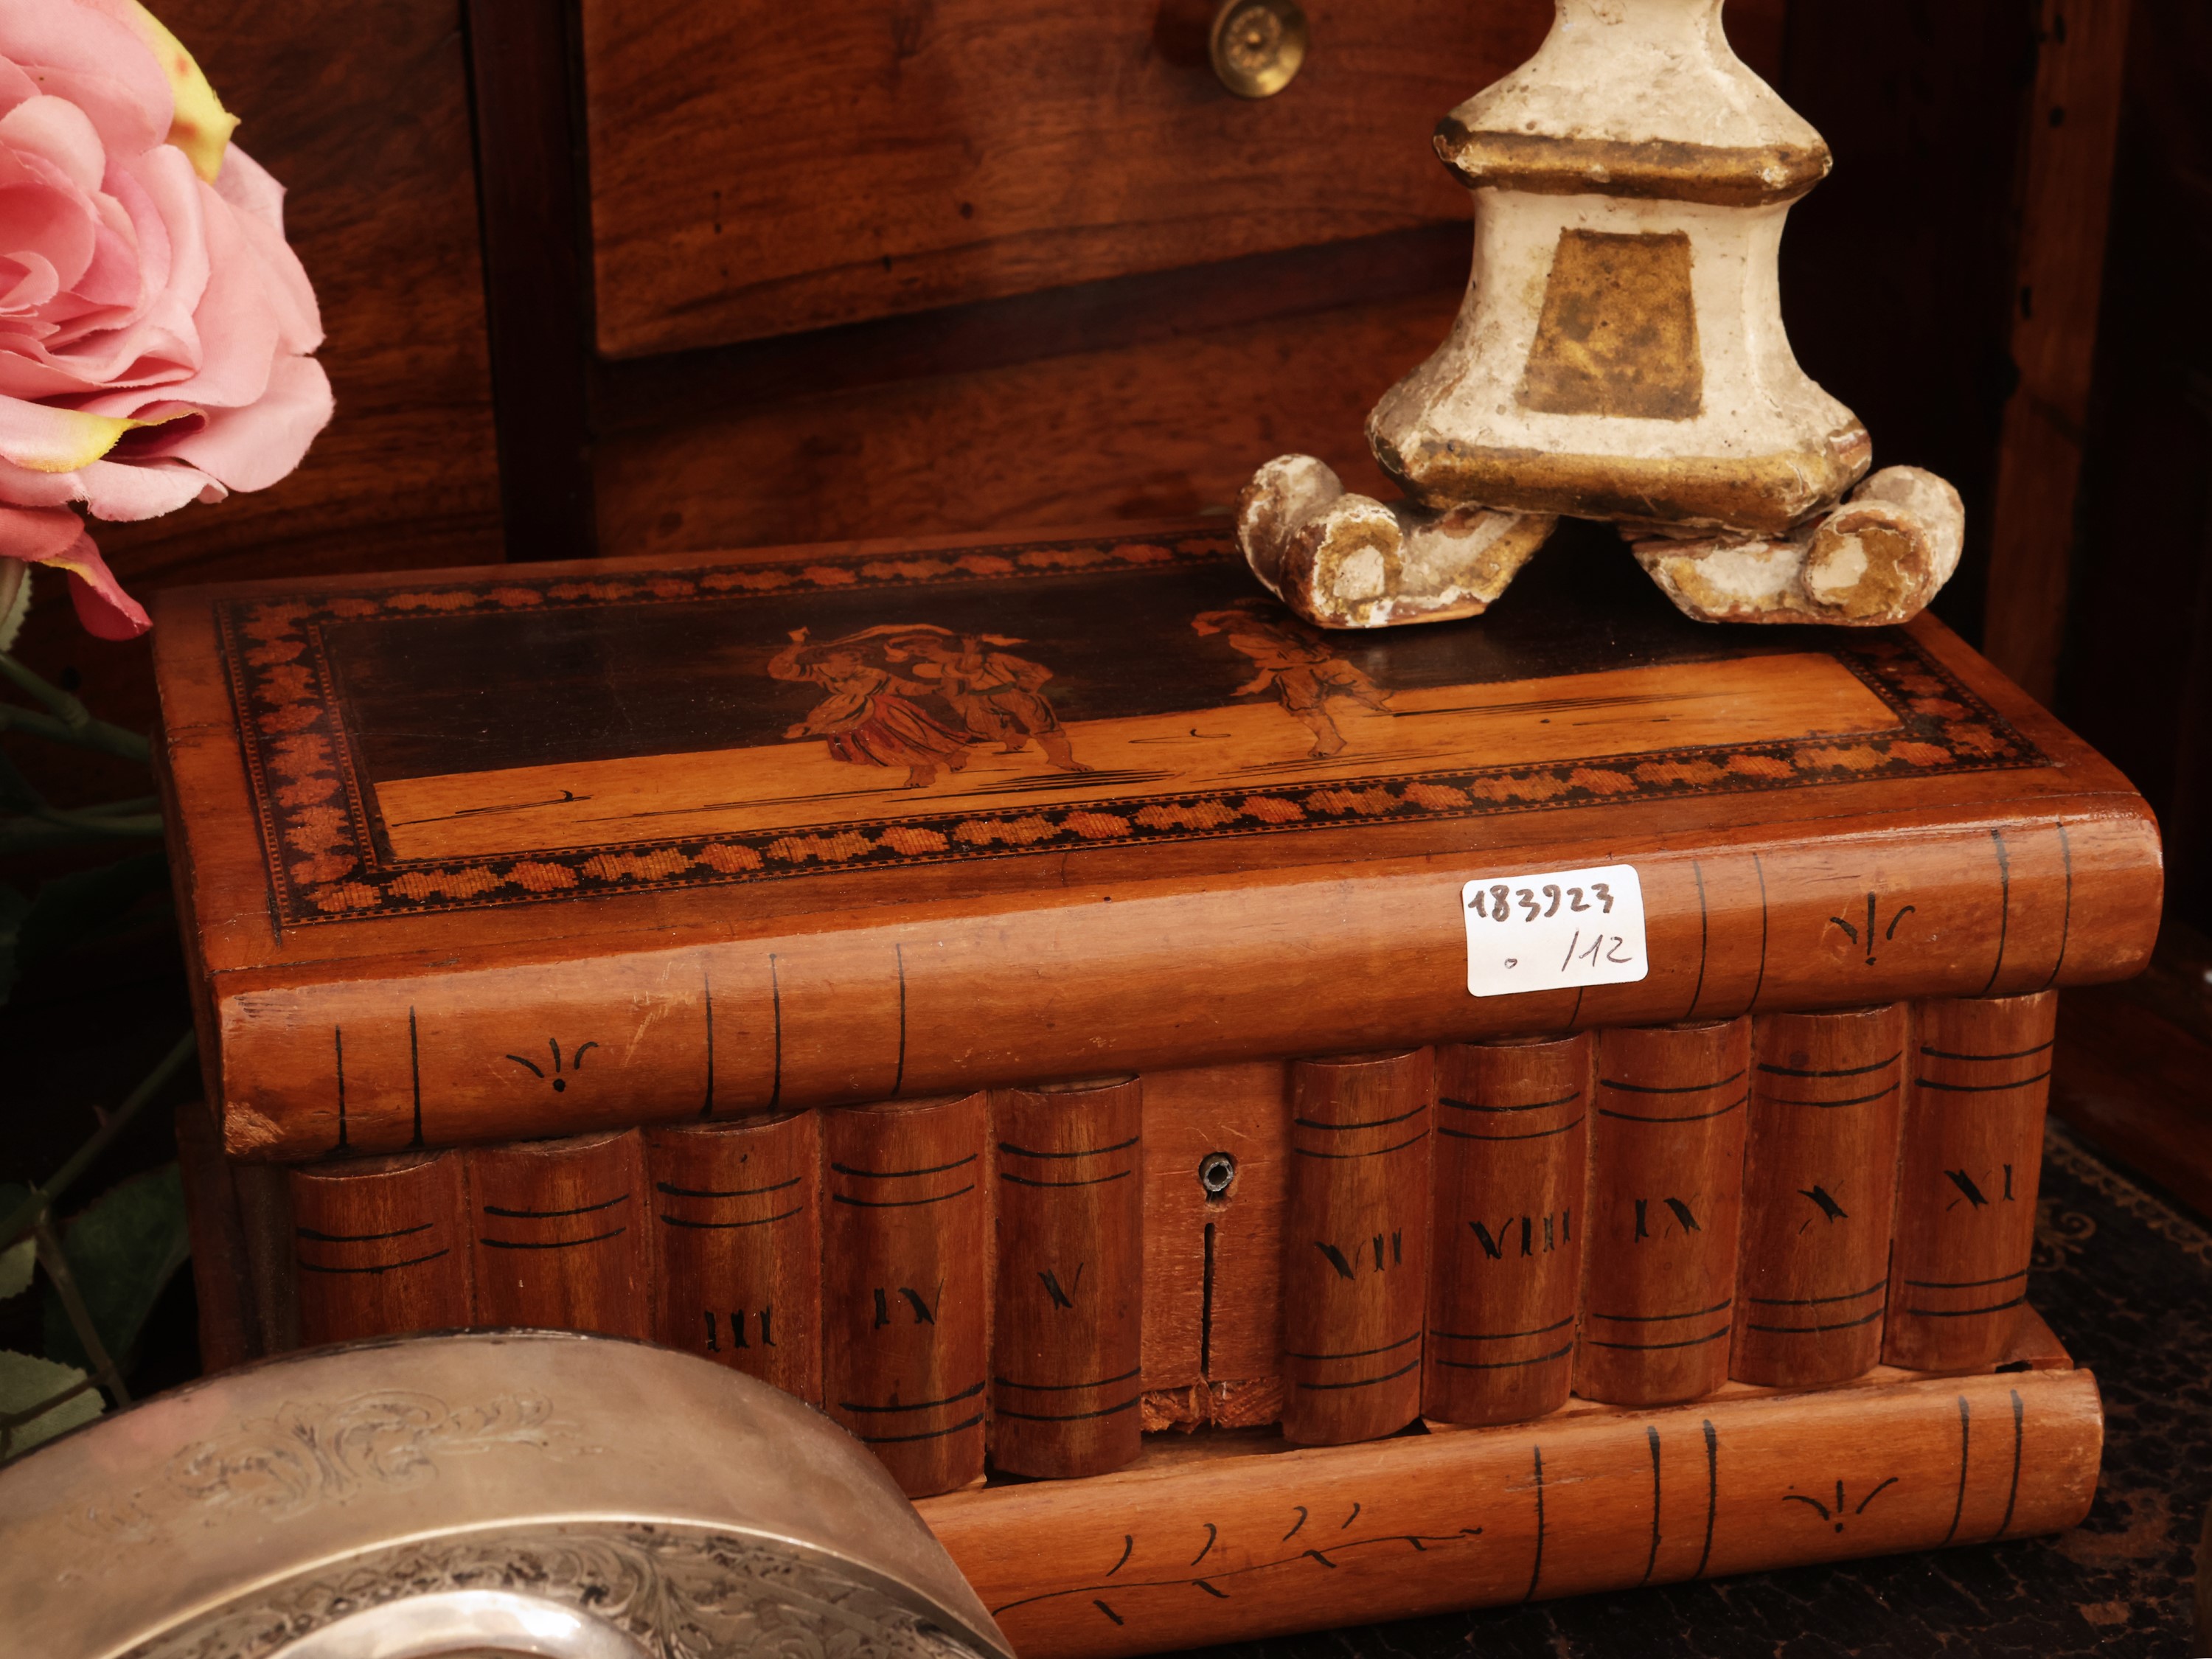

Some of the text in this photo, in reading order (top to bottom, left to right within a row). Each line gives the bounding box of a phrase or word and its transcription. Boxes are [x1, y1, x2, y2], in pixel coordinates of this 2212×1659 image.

[1468, 884, 1615, 922] 183923
[1797, 1180, 1848, 1235] X
[1944, 1163, 2014, 1213] XI
[1469, 1206, 1571, 1259] VIII
[1635, 1191, 1701, 1243] IX
[1315, 1227, 1402, 1281] VII
[874, 1277, 944, 1329] IV
[1037, 1262, 1084, 1310] V
[704, 1304, 776, 1353] III
